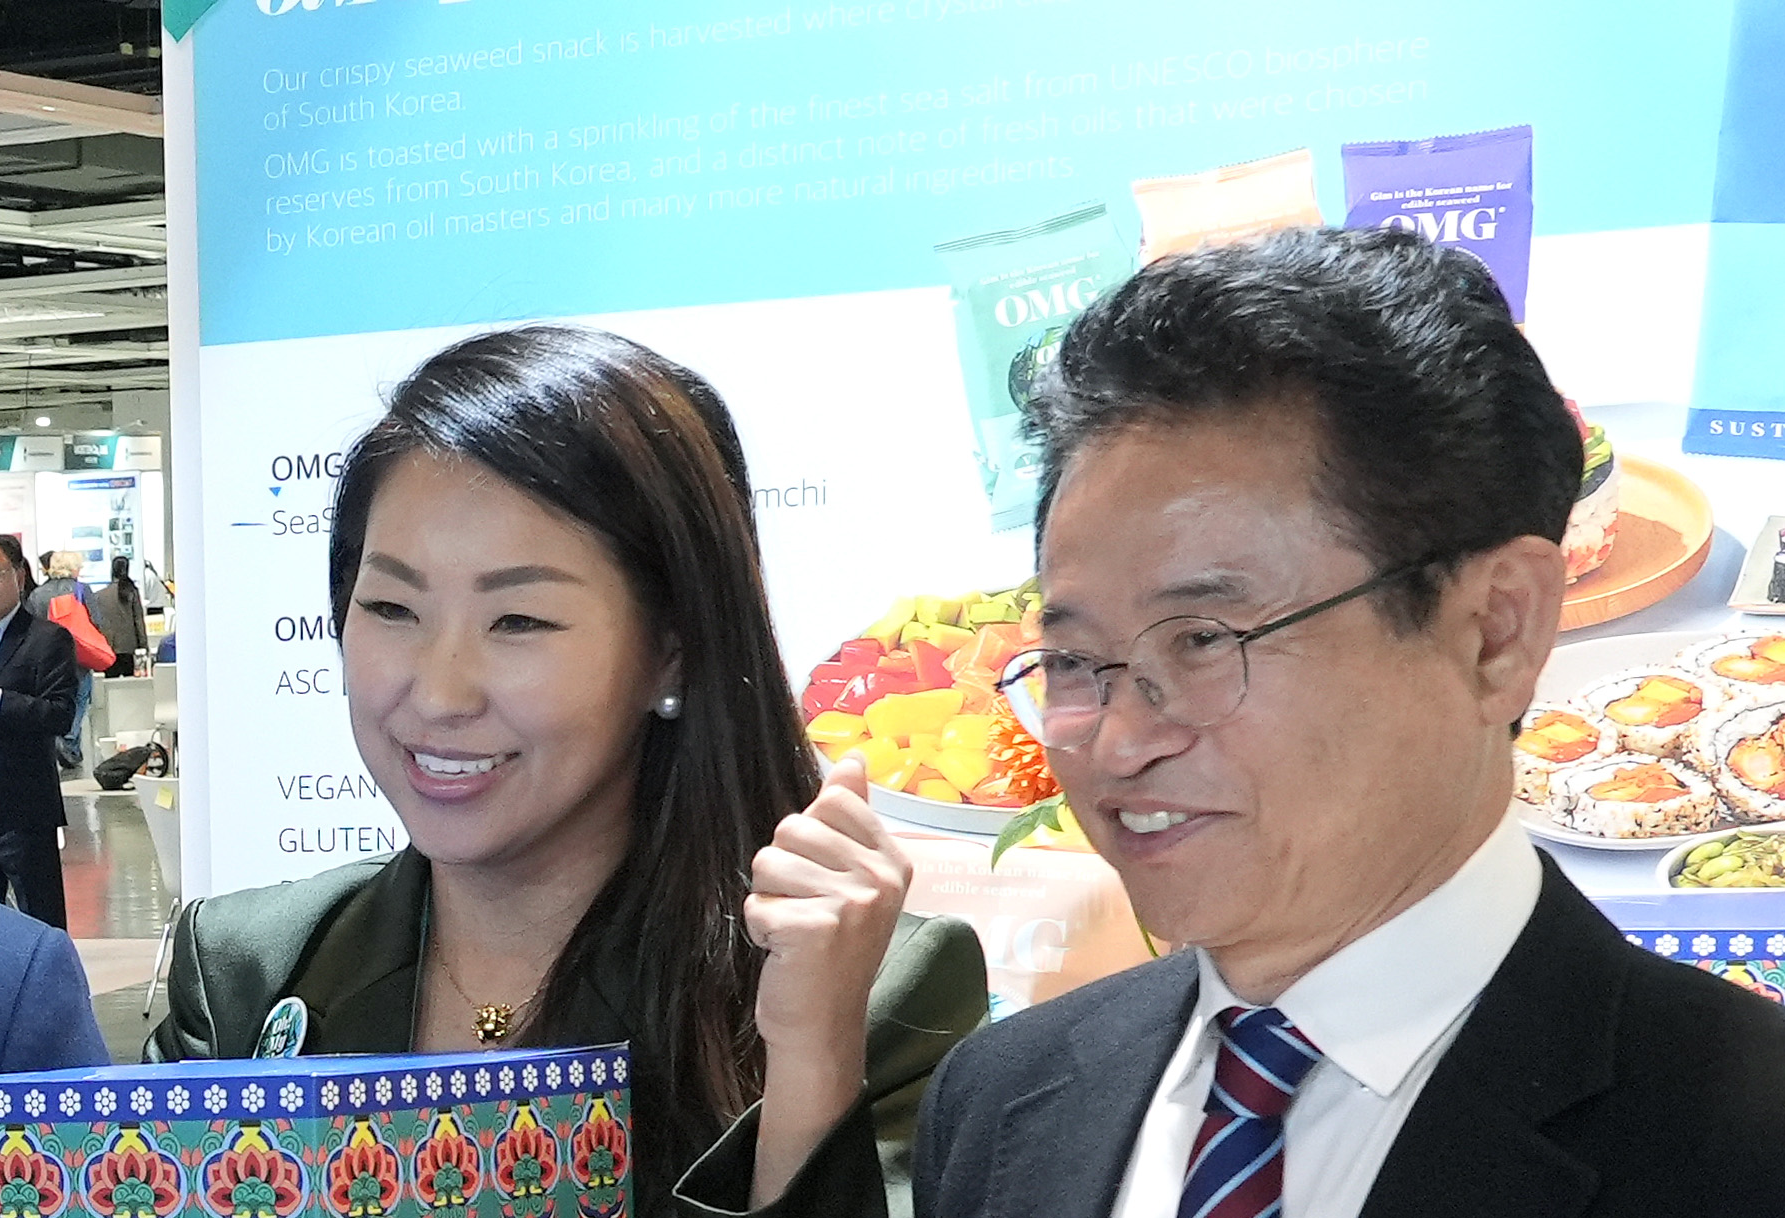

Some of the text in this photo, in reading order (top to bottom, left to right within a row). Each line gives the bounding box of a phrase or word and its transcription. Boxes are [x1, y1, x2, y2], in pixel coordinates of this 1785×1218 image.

[264, 0, 895, 93] Our crispy seaweed snack is harvested where
[264, 90, 466, 130] of South Korea.
[265, 33, 1430, 179] OMG is toasted with a sprinkling of the finest sea salt from UNESCO biosphere
[265, 78, 1428, 215] reserves from South Korea, and a distinct note of fresh oils that were chosen
[1370, 181, 1512, 201] Gim is the Korean name for
[1401, 195, 1480, 209] edible seaweed
[266, 227, 295, 256] by
[306, 220, 396, 249] Korean
[407, 212, 434, 239] oil
[445, 206, 550, 236] masters
[560, 194, 610, 225] and
[620, 191, 697, 219] many
[708, 184, 783, 211] more
[795, 165, 894, 202] natural
[995, 277, 1101, 328] OMG
[272, 453, 344, 482] OMG
[754, 478, 828, 509] mchi
[272, 508, 333, 535] SeaS
[275, 669, 331, 695] ASC
[277, 774, 377, 800] VEGAN
[279, 827, 396, 853] GLUTEN
